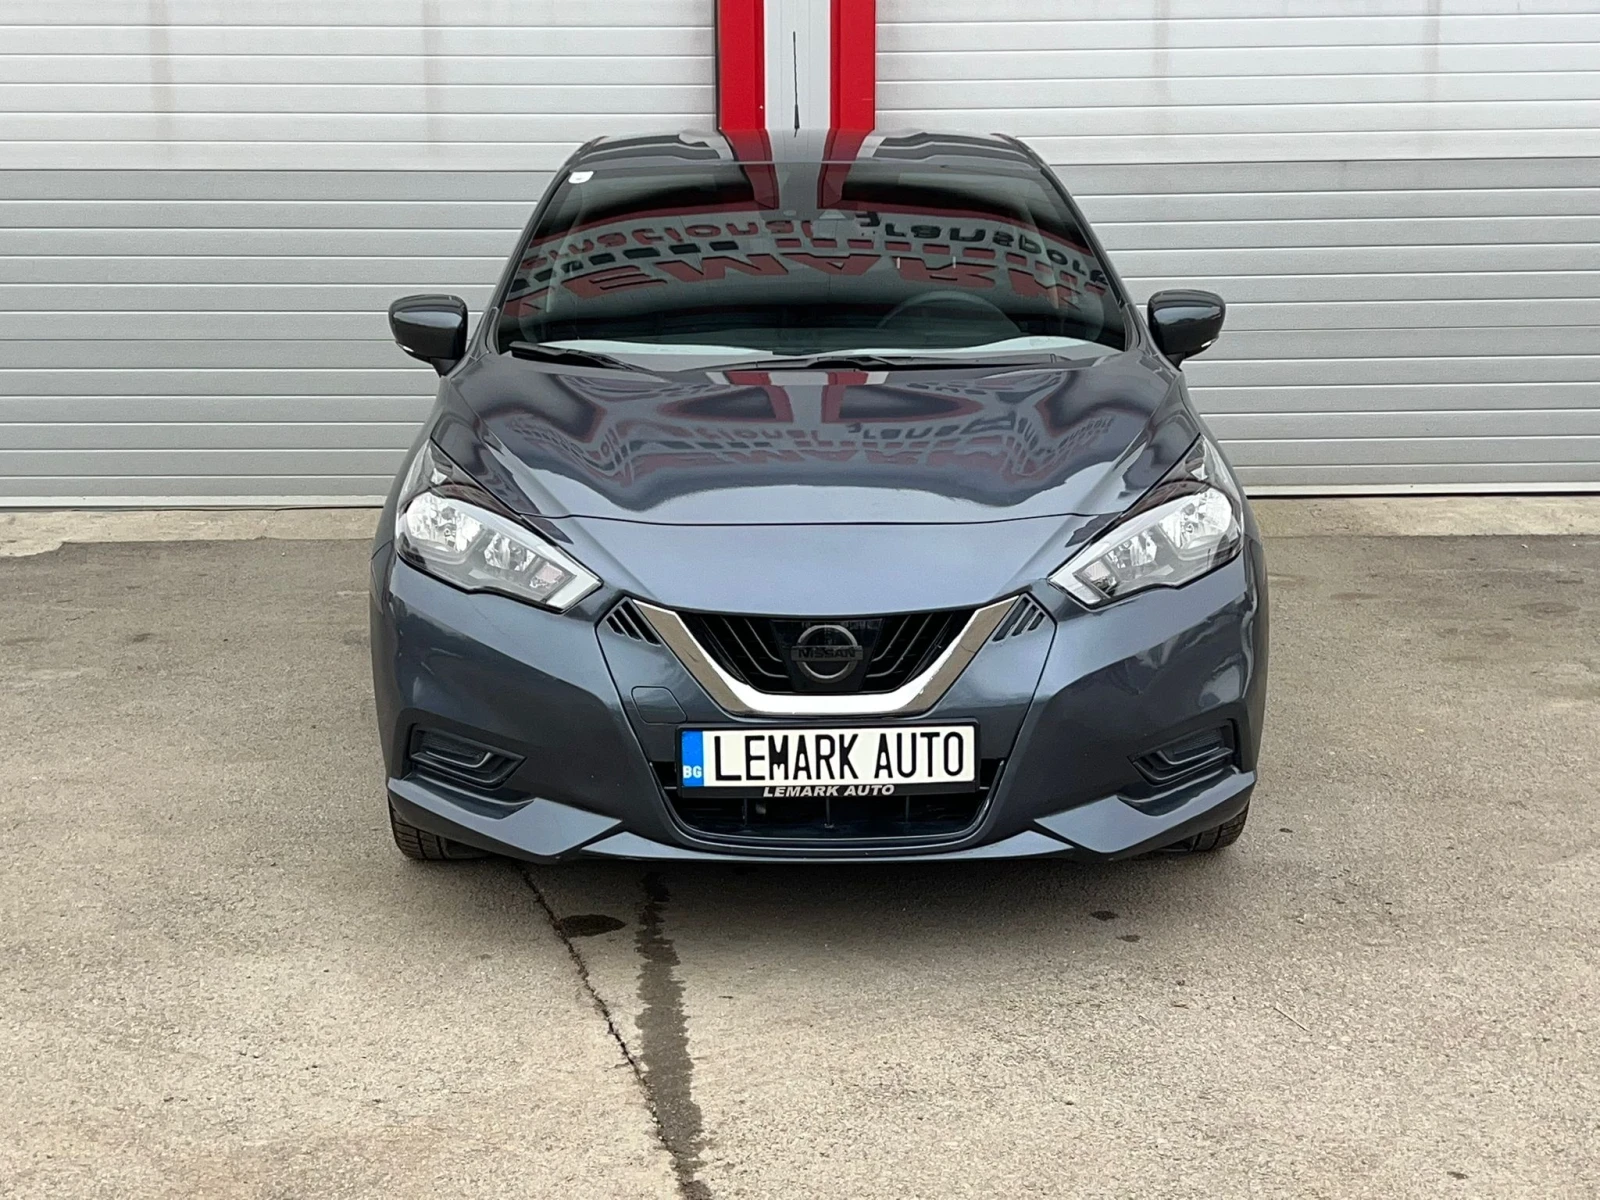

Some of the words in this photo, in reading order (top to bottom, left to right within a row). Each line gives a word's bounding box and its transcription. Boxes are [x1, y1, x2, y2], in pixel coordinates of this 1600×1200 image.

[798, 648, 857, 658] NISSAN
[714, 733, 859, 781] LEMARK
[874, 731, 964, 779] AUTO
[682, 765, 703, 779] BG
[763, 785, 839, 798] LEMARK
[843, 784, 895, 796] AUTO
